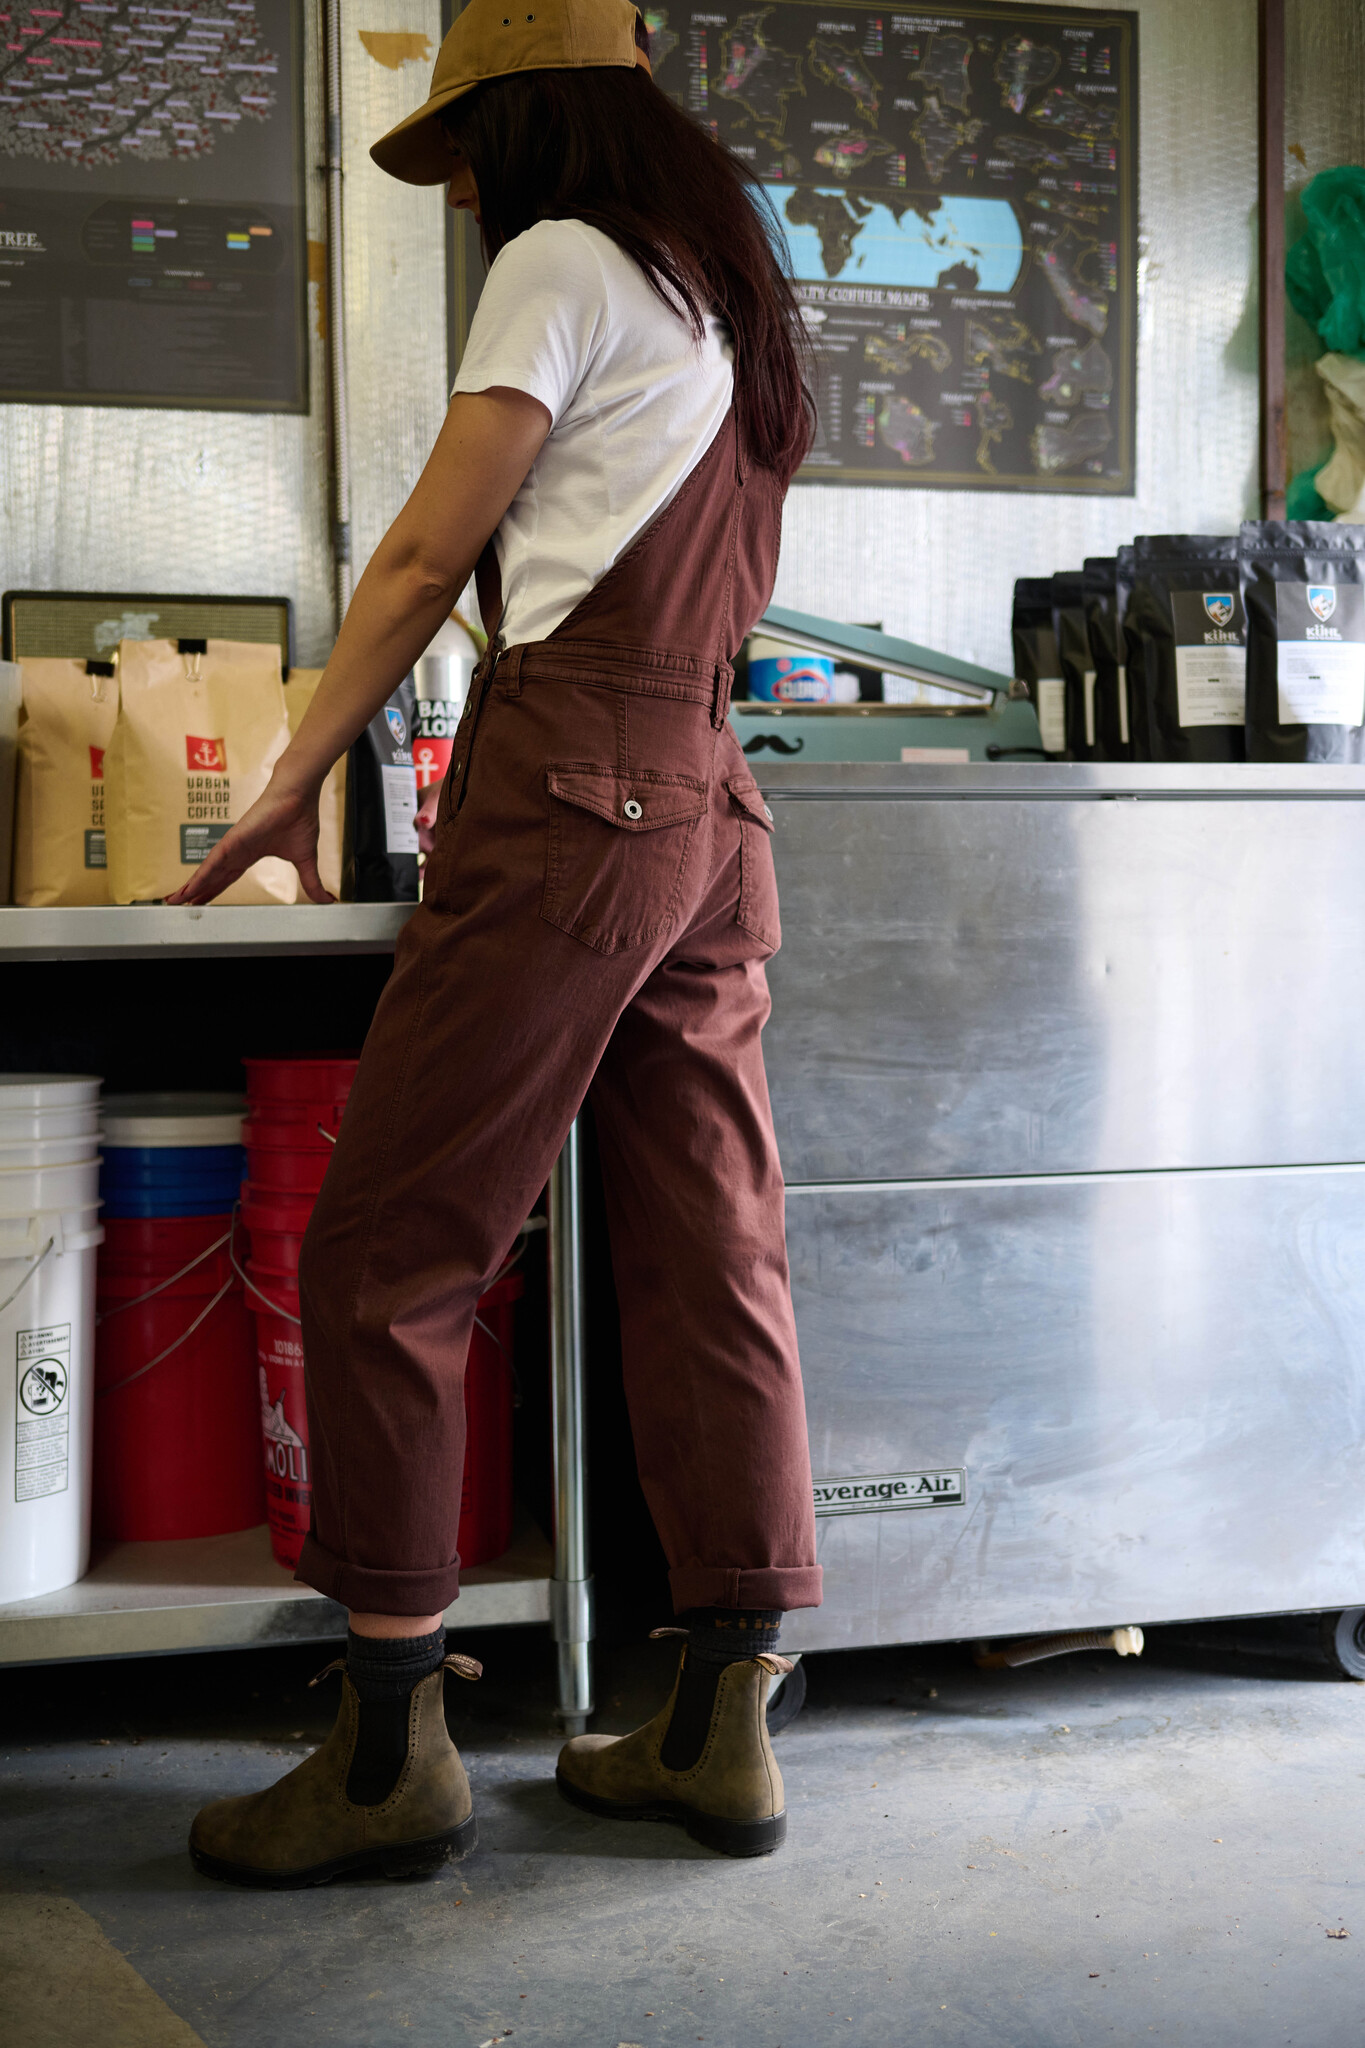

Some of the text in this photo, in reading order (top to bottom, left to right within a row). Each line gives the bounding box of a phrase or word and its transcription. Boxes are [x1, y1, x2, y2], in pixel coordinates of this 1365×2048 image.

[187, 777, 230, 790] URBAN
[187, 791, 230, 804] SAILOR
[187, 806, 230, 819] COFFEE
